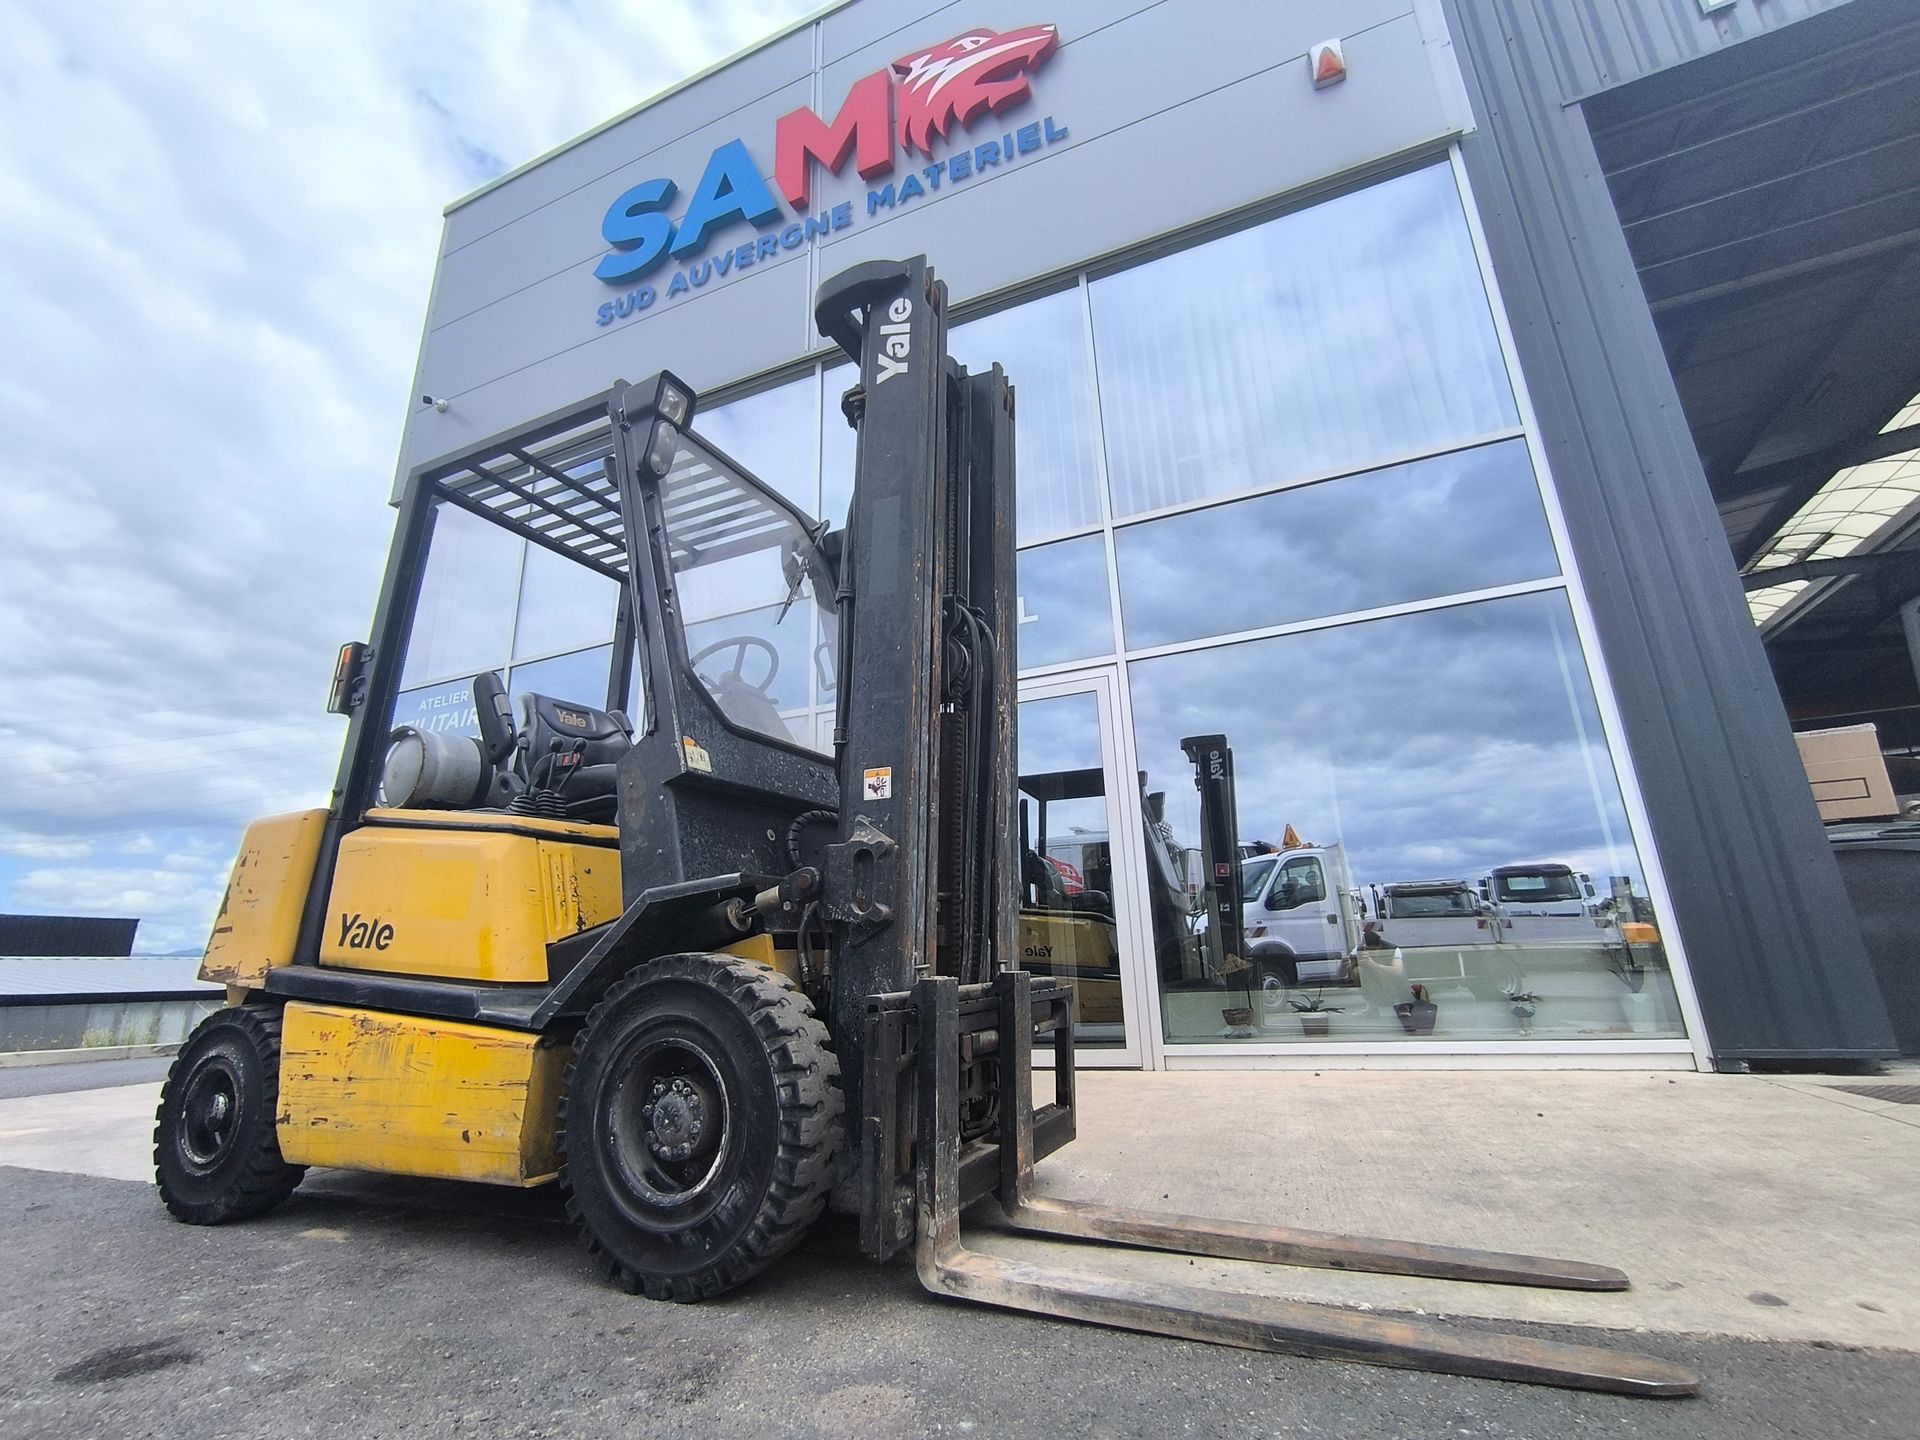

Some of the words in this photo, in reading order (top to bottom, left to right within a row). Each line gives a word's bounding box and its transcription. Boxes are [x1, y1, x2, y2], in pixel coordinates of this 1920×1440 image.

[593, 69, 895, 285] SAM
[596, 285, 657, 326] SUD
[665, 200, 854, 299] AUVERGNE
[866, 116, 1070, 216] MATERIEL
[876, 297, 913, 385] Yale
[418, 690, 470, 712] ATELIER
[556, 708, 587, 728] Yale
[338, 913, 395, 951] Yale
